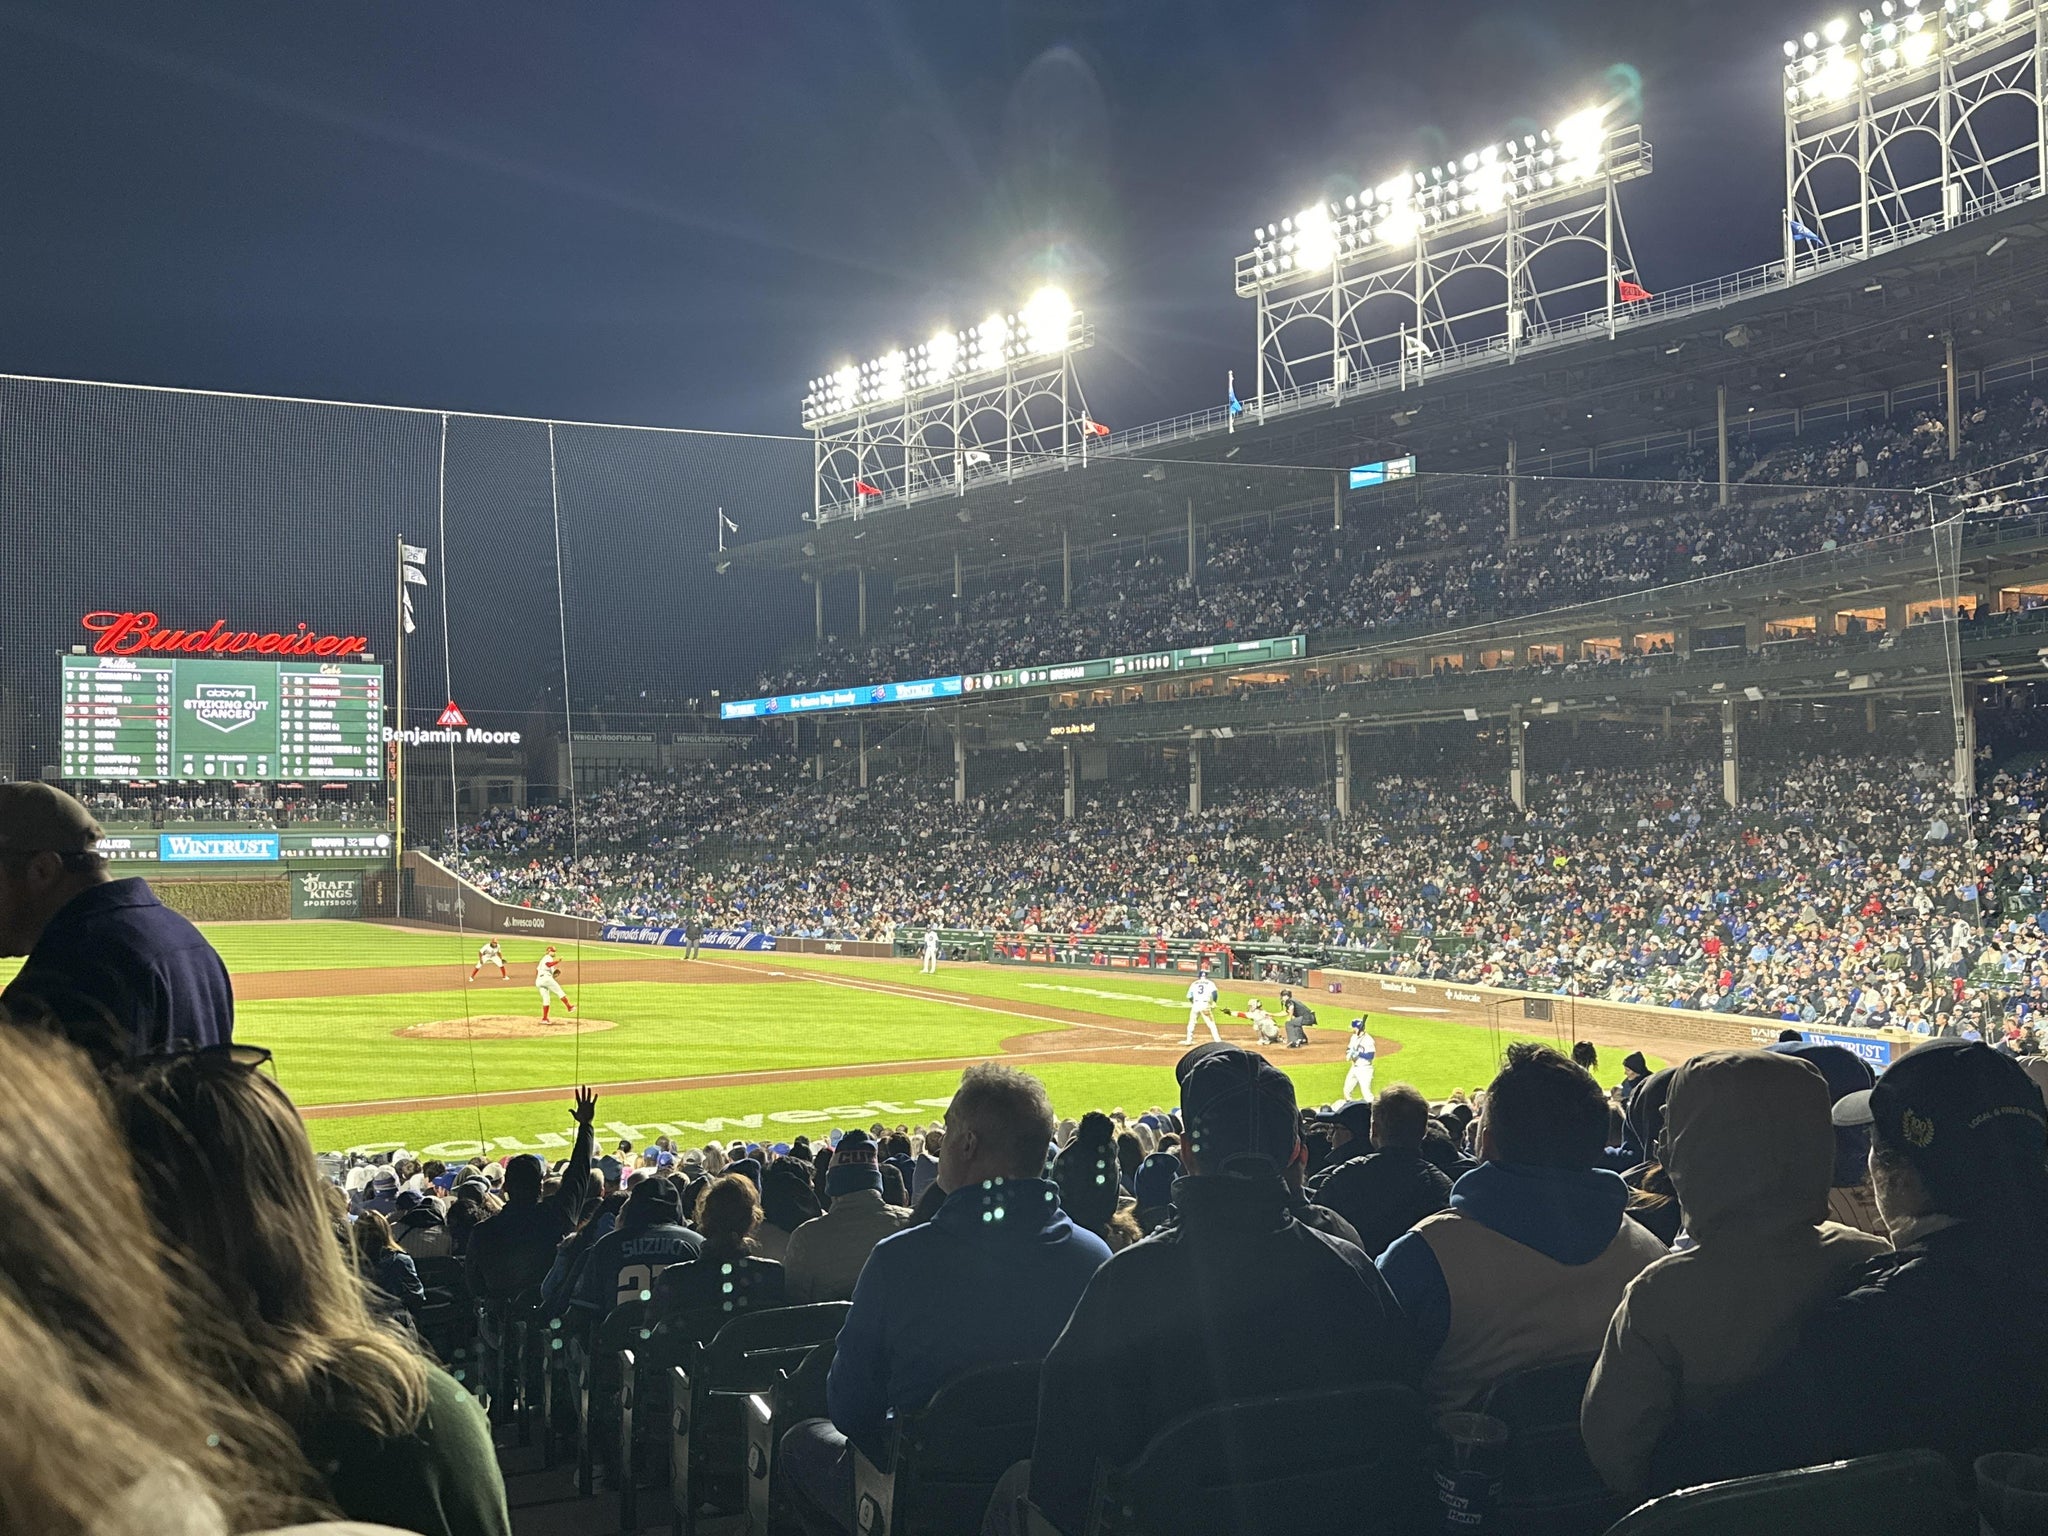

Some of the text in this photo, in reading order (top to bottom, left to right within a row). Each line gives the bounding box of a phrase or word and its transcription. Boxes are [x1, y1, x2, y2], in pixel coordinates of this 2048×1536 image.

[82, 611, 368, 656] Budweiser
[975, 678, 981, 688] 2
[184, 699, 269, 711] STRIKING OUT
[201, 708, 251, 719] CANCER
[382, 726, 521, 747] Benjamin Moore
[183, 762, 194, 775] 4
[236, 763, 245, 776] 1
[257, 763, 267, 776] 3
[168, 836, 274, 854] WINTRUST
[303, 880, 355, 892] DRAFT
[310, 890, 353, 899] KINGS
[303, 899, 358, 907] SPORTSBOOK
[512, 916, 545, 929] Invesco QQQ
[607, 926, 659, 945] Reynolds Wrap
[716, 933, 739, 949] Wrap
[1198, 984, 1204, 995] 3
[1452, 990, 1481, 1003] Advocate
